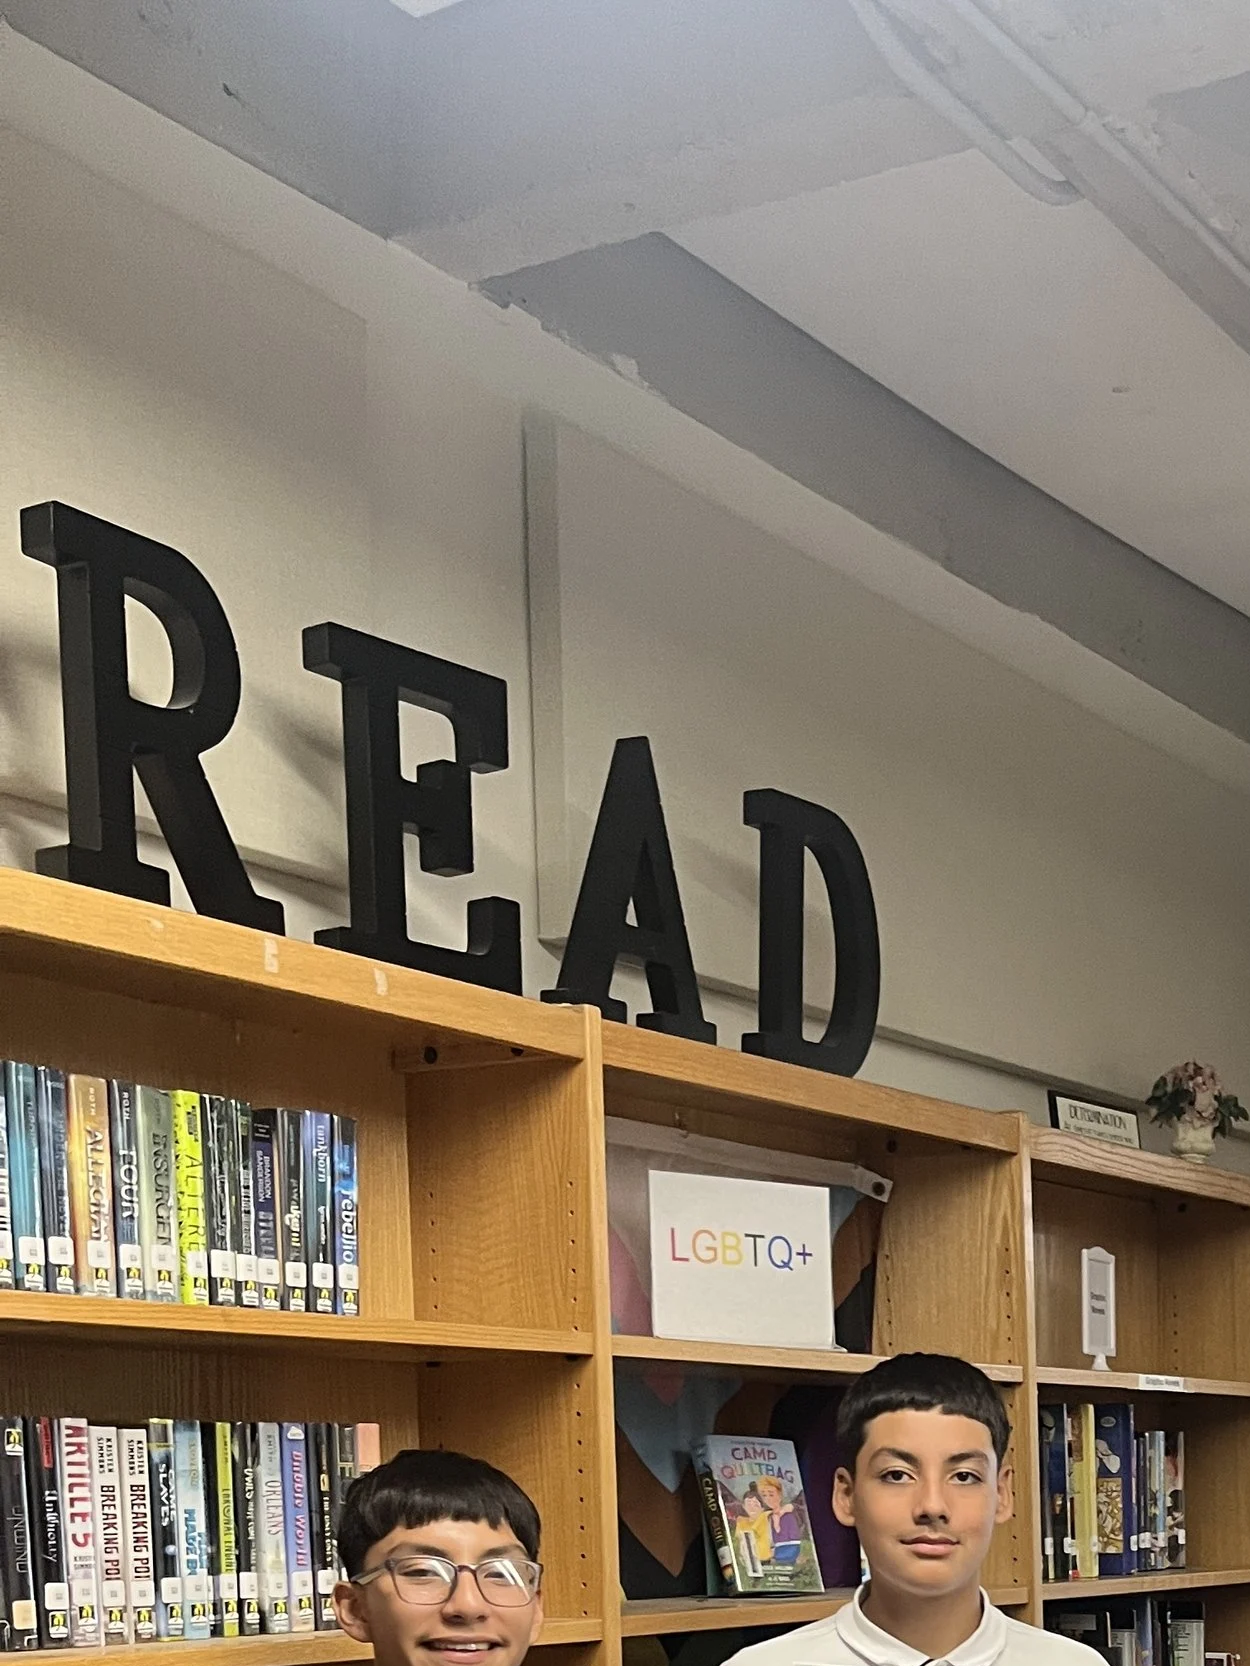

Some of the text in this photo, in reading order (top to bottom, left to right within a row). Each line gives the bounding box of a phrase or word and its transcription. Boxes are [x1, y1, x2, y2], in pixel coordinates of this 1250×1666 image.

[20, 499, 880, 1077] READ
[315, 1124, 328, 1183] tankborn
[120, 1149, 139, 1219] FOUR
[670, 1227, 812, 1271] LGBTQ+
[97, 1437, 105, 1475] SIMMONS
[105, 1437, 114, 1473] KRISTEN
[127, 1439, 136, 1476] SIMMONS
[136, 1439, 145, 1475] KRISTEN
[721, 1463, 795, 1484] QUILTBAG
[731, 1447, 777, 1461] CAMP
[64, 1424, 92, 1548] ARTICLE 5
[158, 1463, 168, 1526] SLAVES
[265, 1480, 283, 1536] ORLEANS
[702, 1478, 717, 1512] CAMP
[100, 1484, 119, 1554] BREAKING
[129, 1484, 148, 1553] BREAKING
